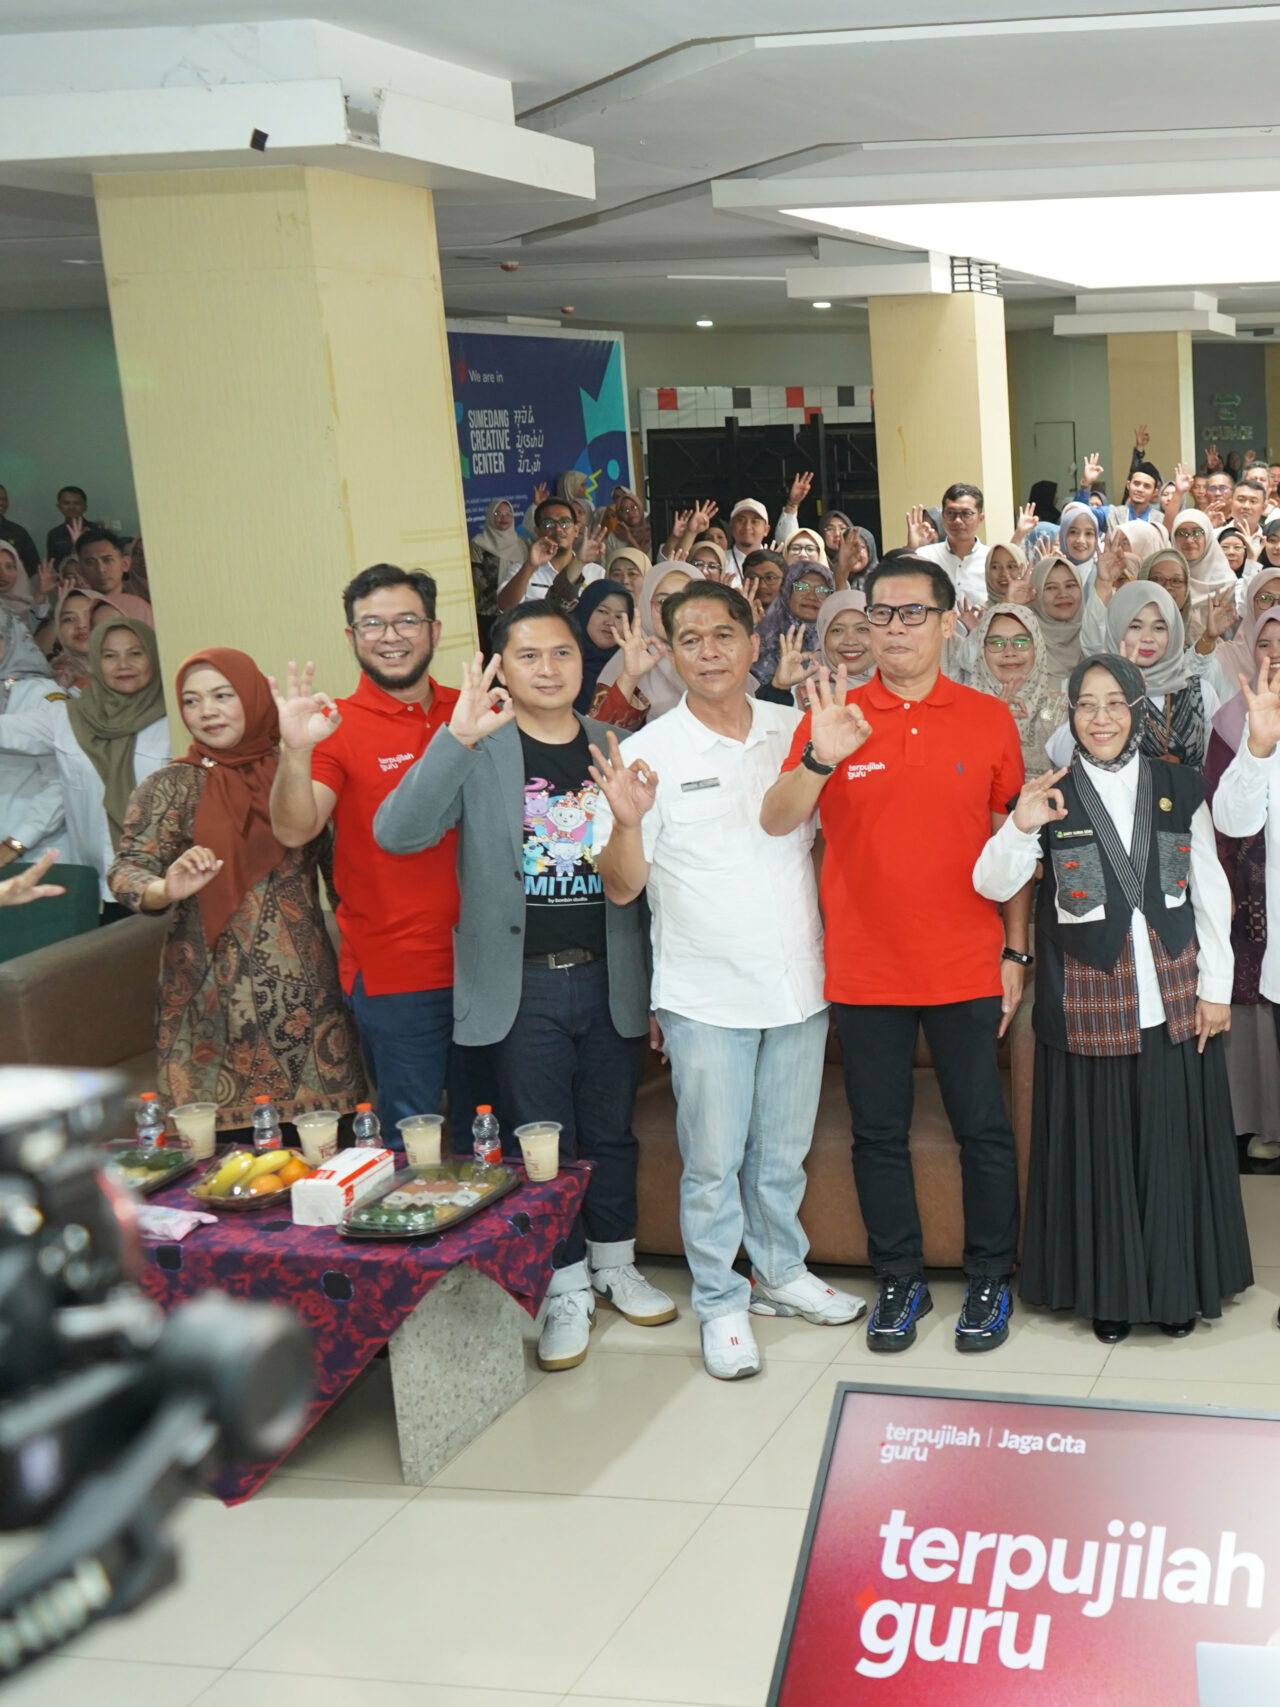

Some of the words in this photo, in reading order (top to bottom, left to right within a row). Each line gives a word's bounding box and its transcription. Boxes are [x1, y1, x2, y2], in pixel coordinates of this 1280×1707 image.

[468, 369, 481, 382] We
[482, 373, 495, 383] are
[495, 370, 504, 383] in
[468, 409, 510, 428] SUMEDANG
[470, 428, 511, 452] CREATIVE
[472, 452, 506, 475] CENTER
[885, 1422, 981, 1449] terpujilah
[998, 1429, 1043, 1454] Jaga
[880, 1443, 928, 1464] guru
[879, 1509, 1265, 1618] terpujilah
[855, 1599, 1051, 1679] guru
